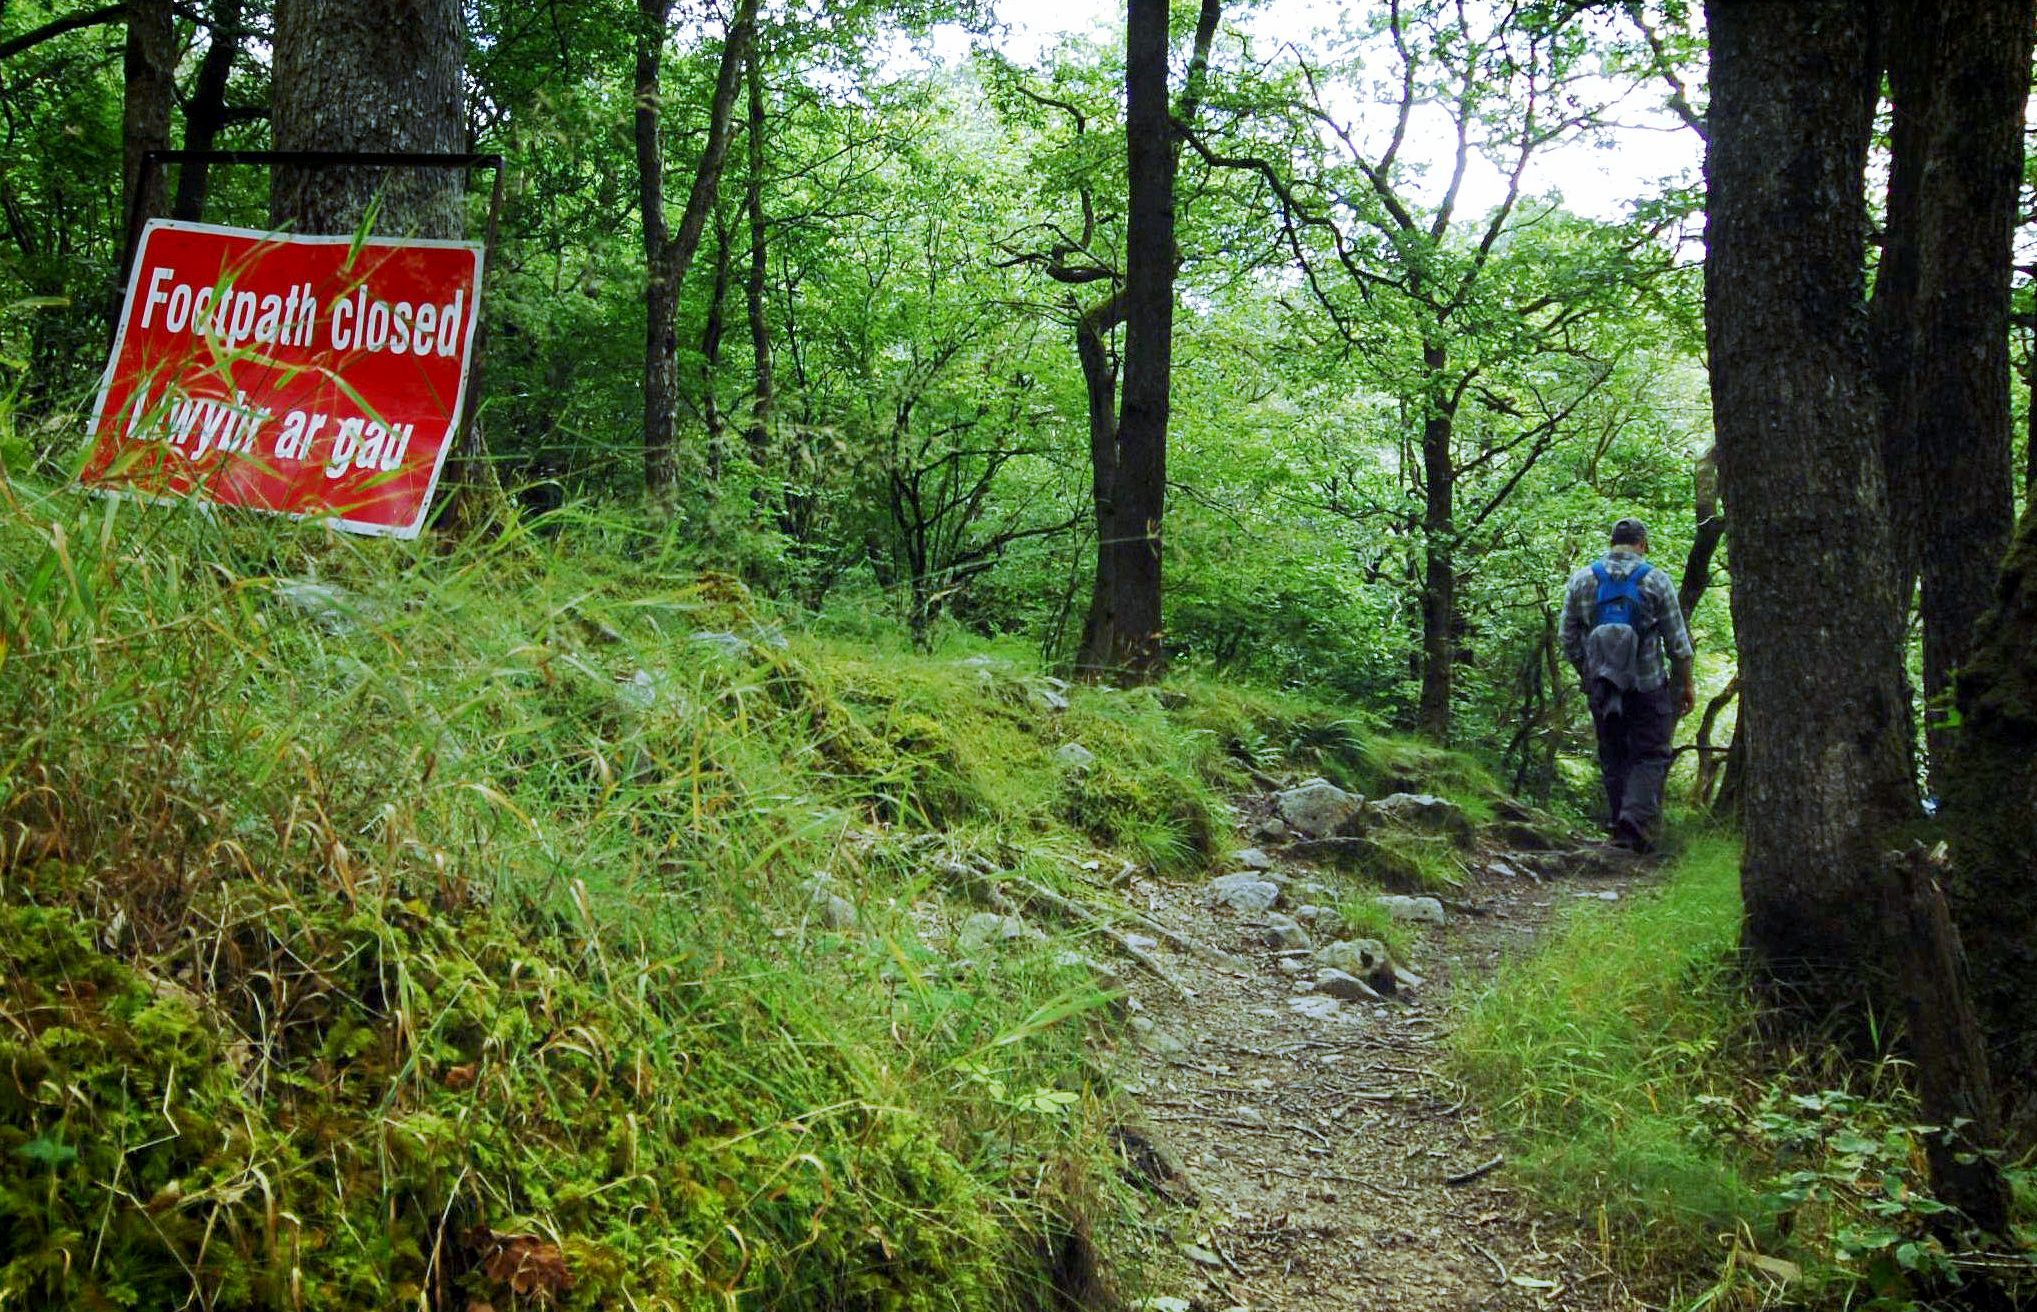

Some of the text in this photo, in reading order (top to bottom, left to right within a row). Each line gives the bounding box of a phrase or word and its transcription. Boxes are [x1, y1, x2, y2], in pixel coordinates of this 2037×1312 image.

[141, 267, 464, 357] Footpath closed
[274, 410, 327, 461] ar
[325, 416, 414, 479] gau
